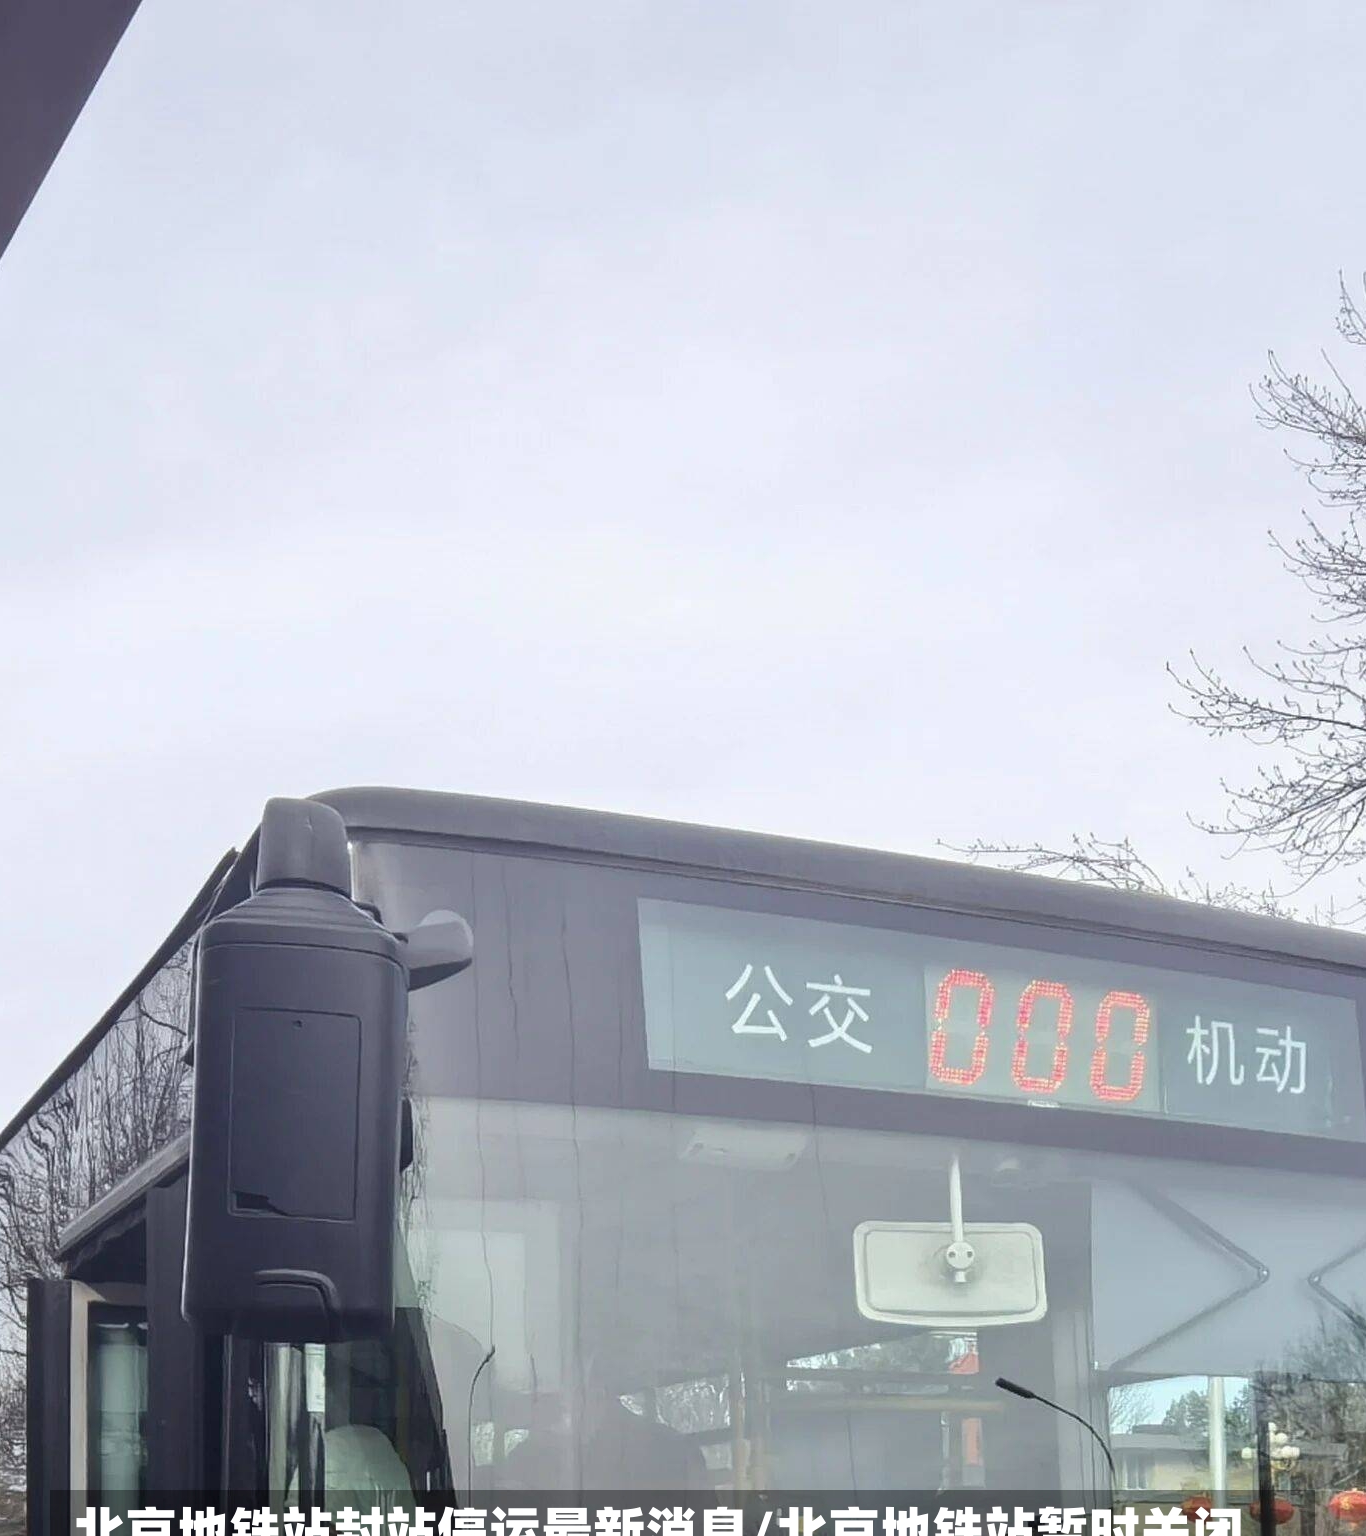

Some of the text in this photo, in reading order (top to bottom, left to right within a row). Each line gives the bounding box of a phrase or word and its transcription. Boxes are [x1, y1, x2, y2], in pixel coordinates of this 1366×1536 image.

[725, 963, 1307, 1102] 公交 000 机动
